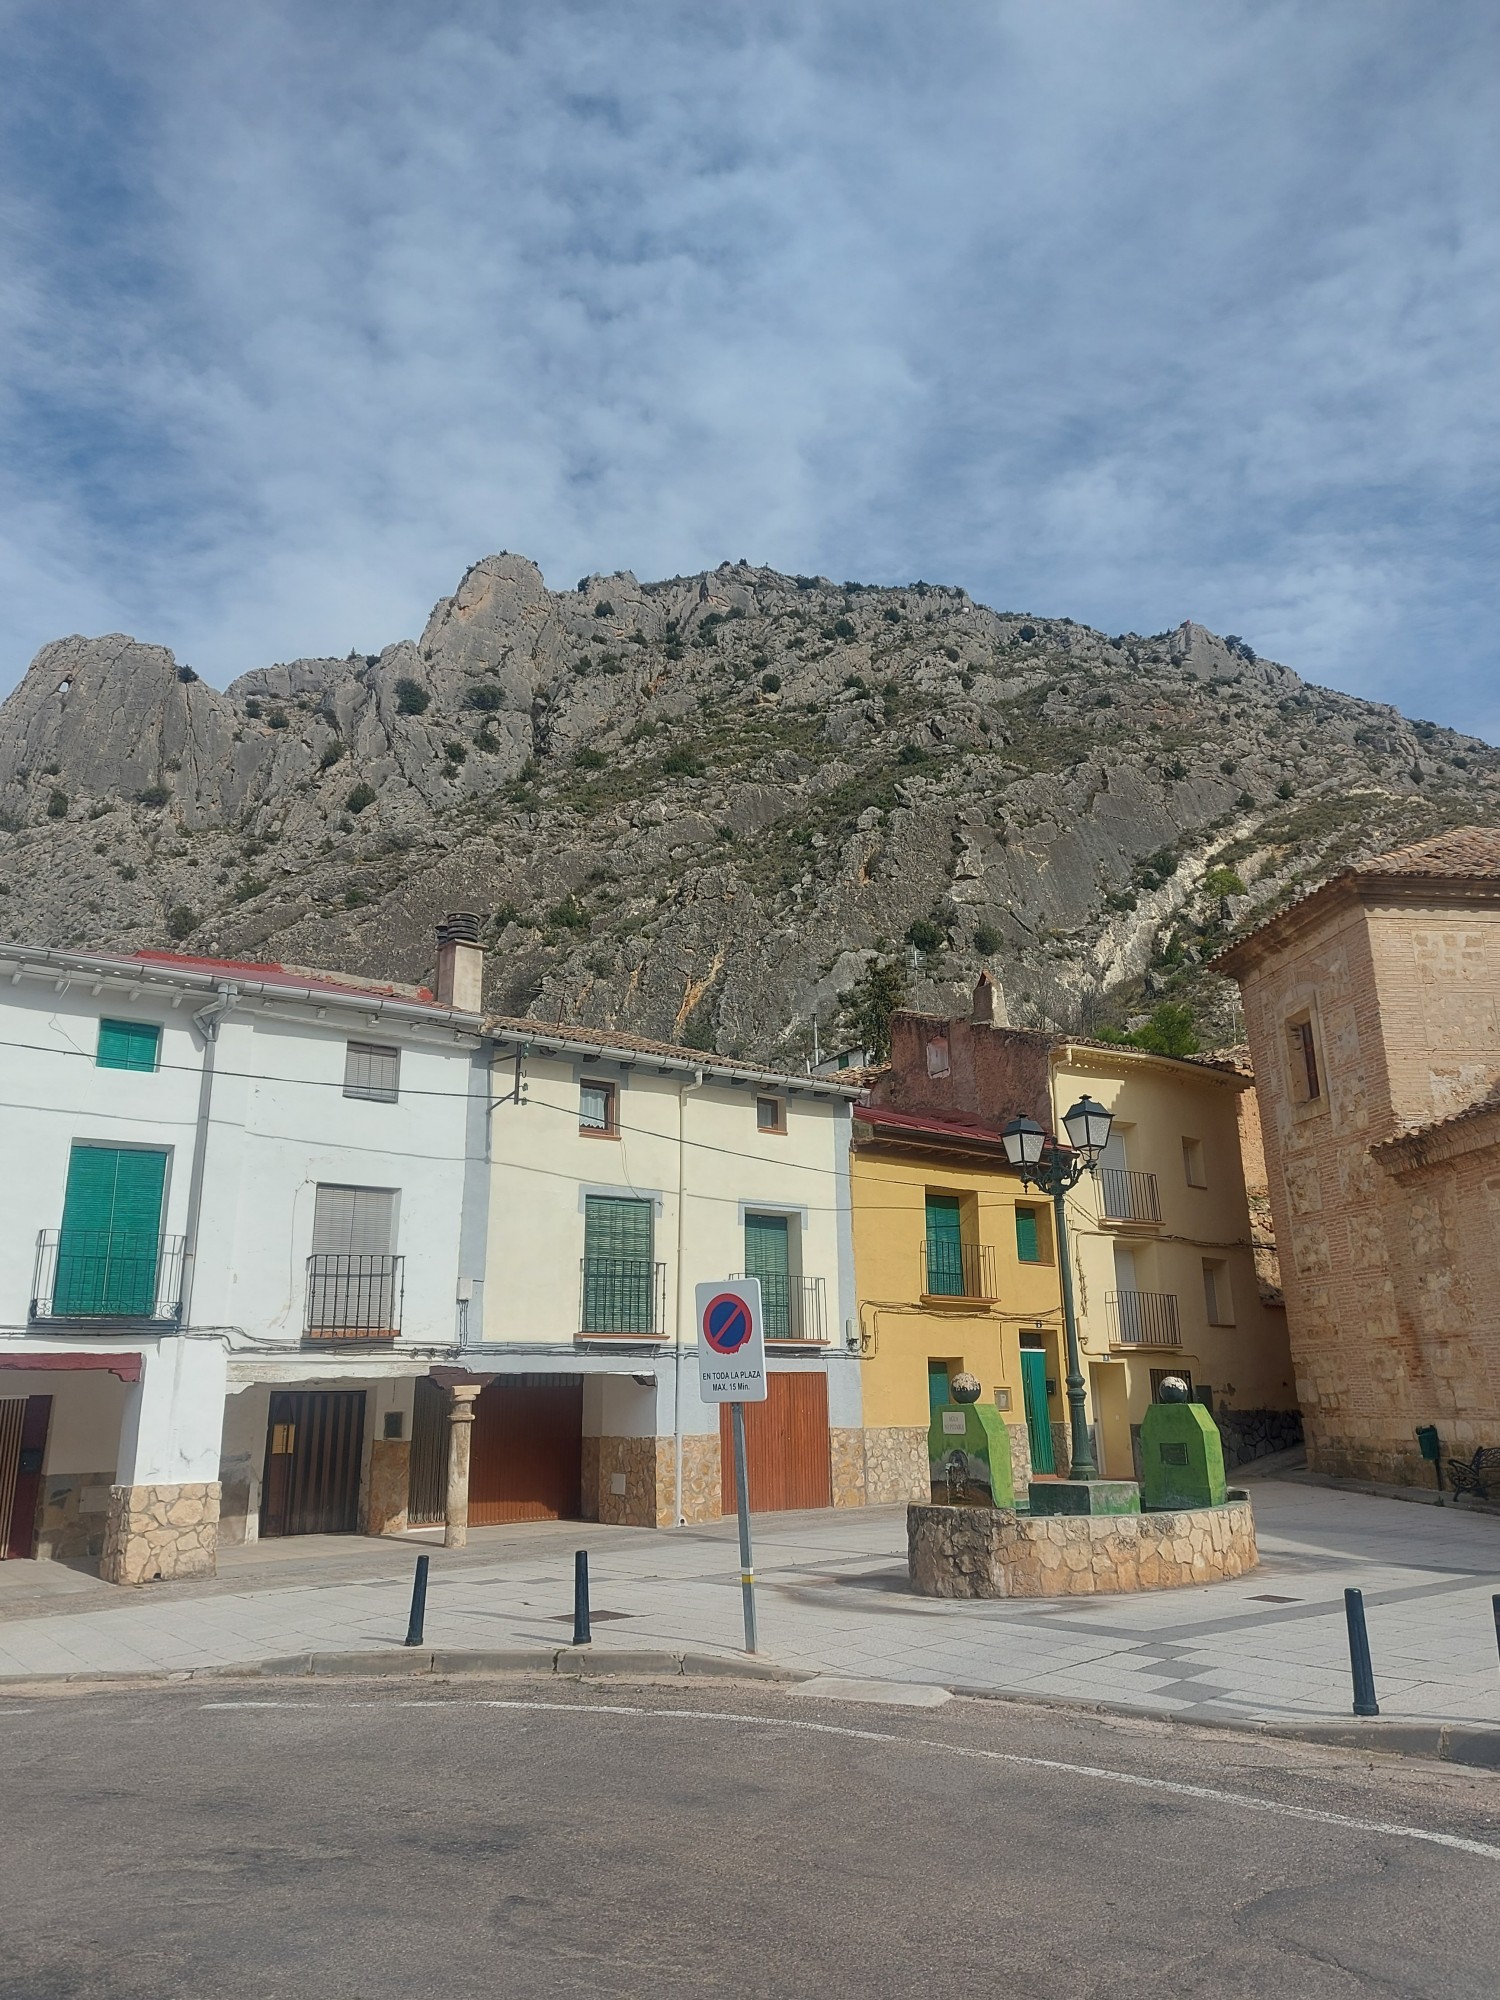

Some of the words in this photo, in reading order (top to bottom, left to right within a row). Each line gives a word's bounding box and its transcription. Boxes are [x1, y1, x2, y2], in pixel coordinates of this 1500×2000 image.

[702, 1372, 711, 1380] EN
[712, 1371, 730, 1380] TODA
[731, 1371, 739, 1379] LA
[740, 1370, 761, 1379] PLAZA
[712, 1383, 728, 1391] MAX.
[729, 1383, 737, 1391] 15
[737, 1382, 750, 1390] Min.
